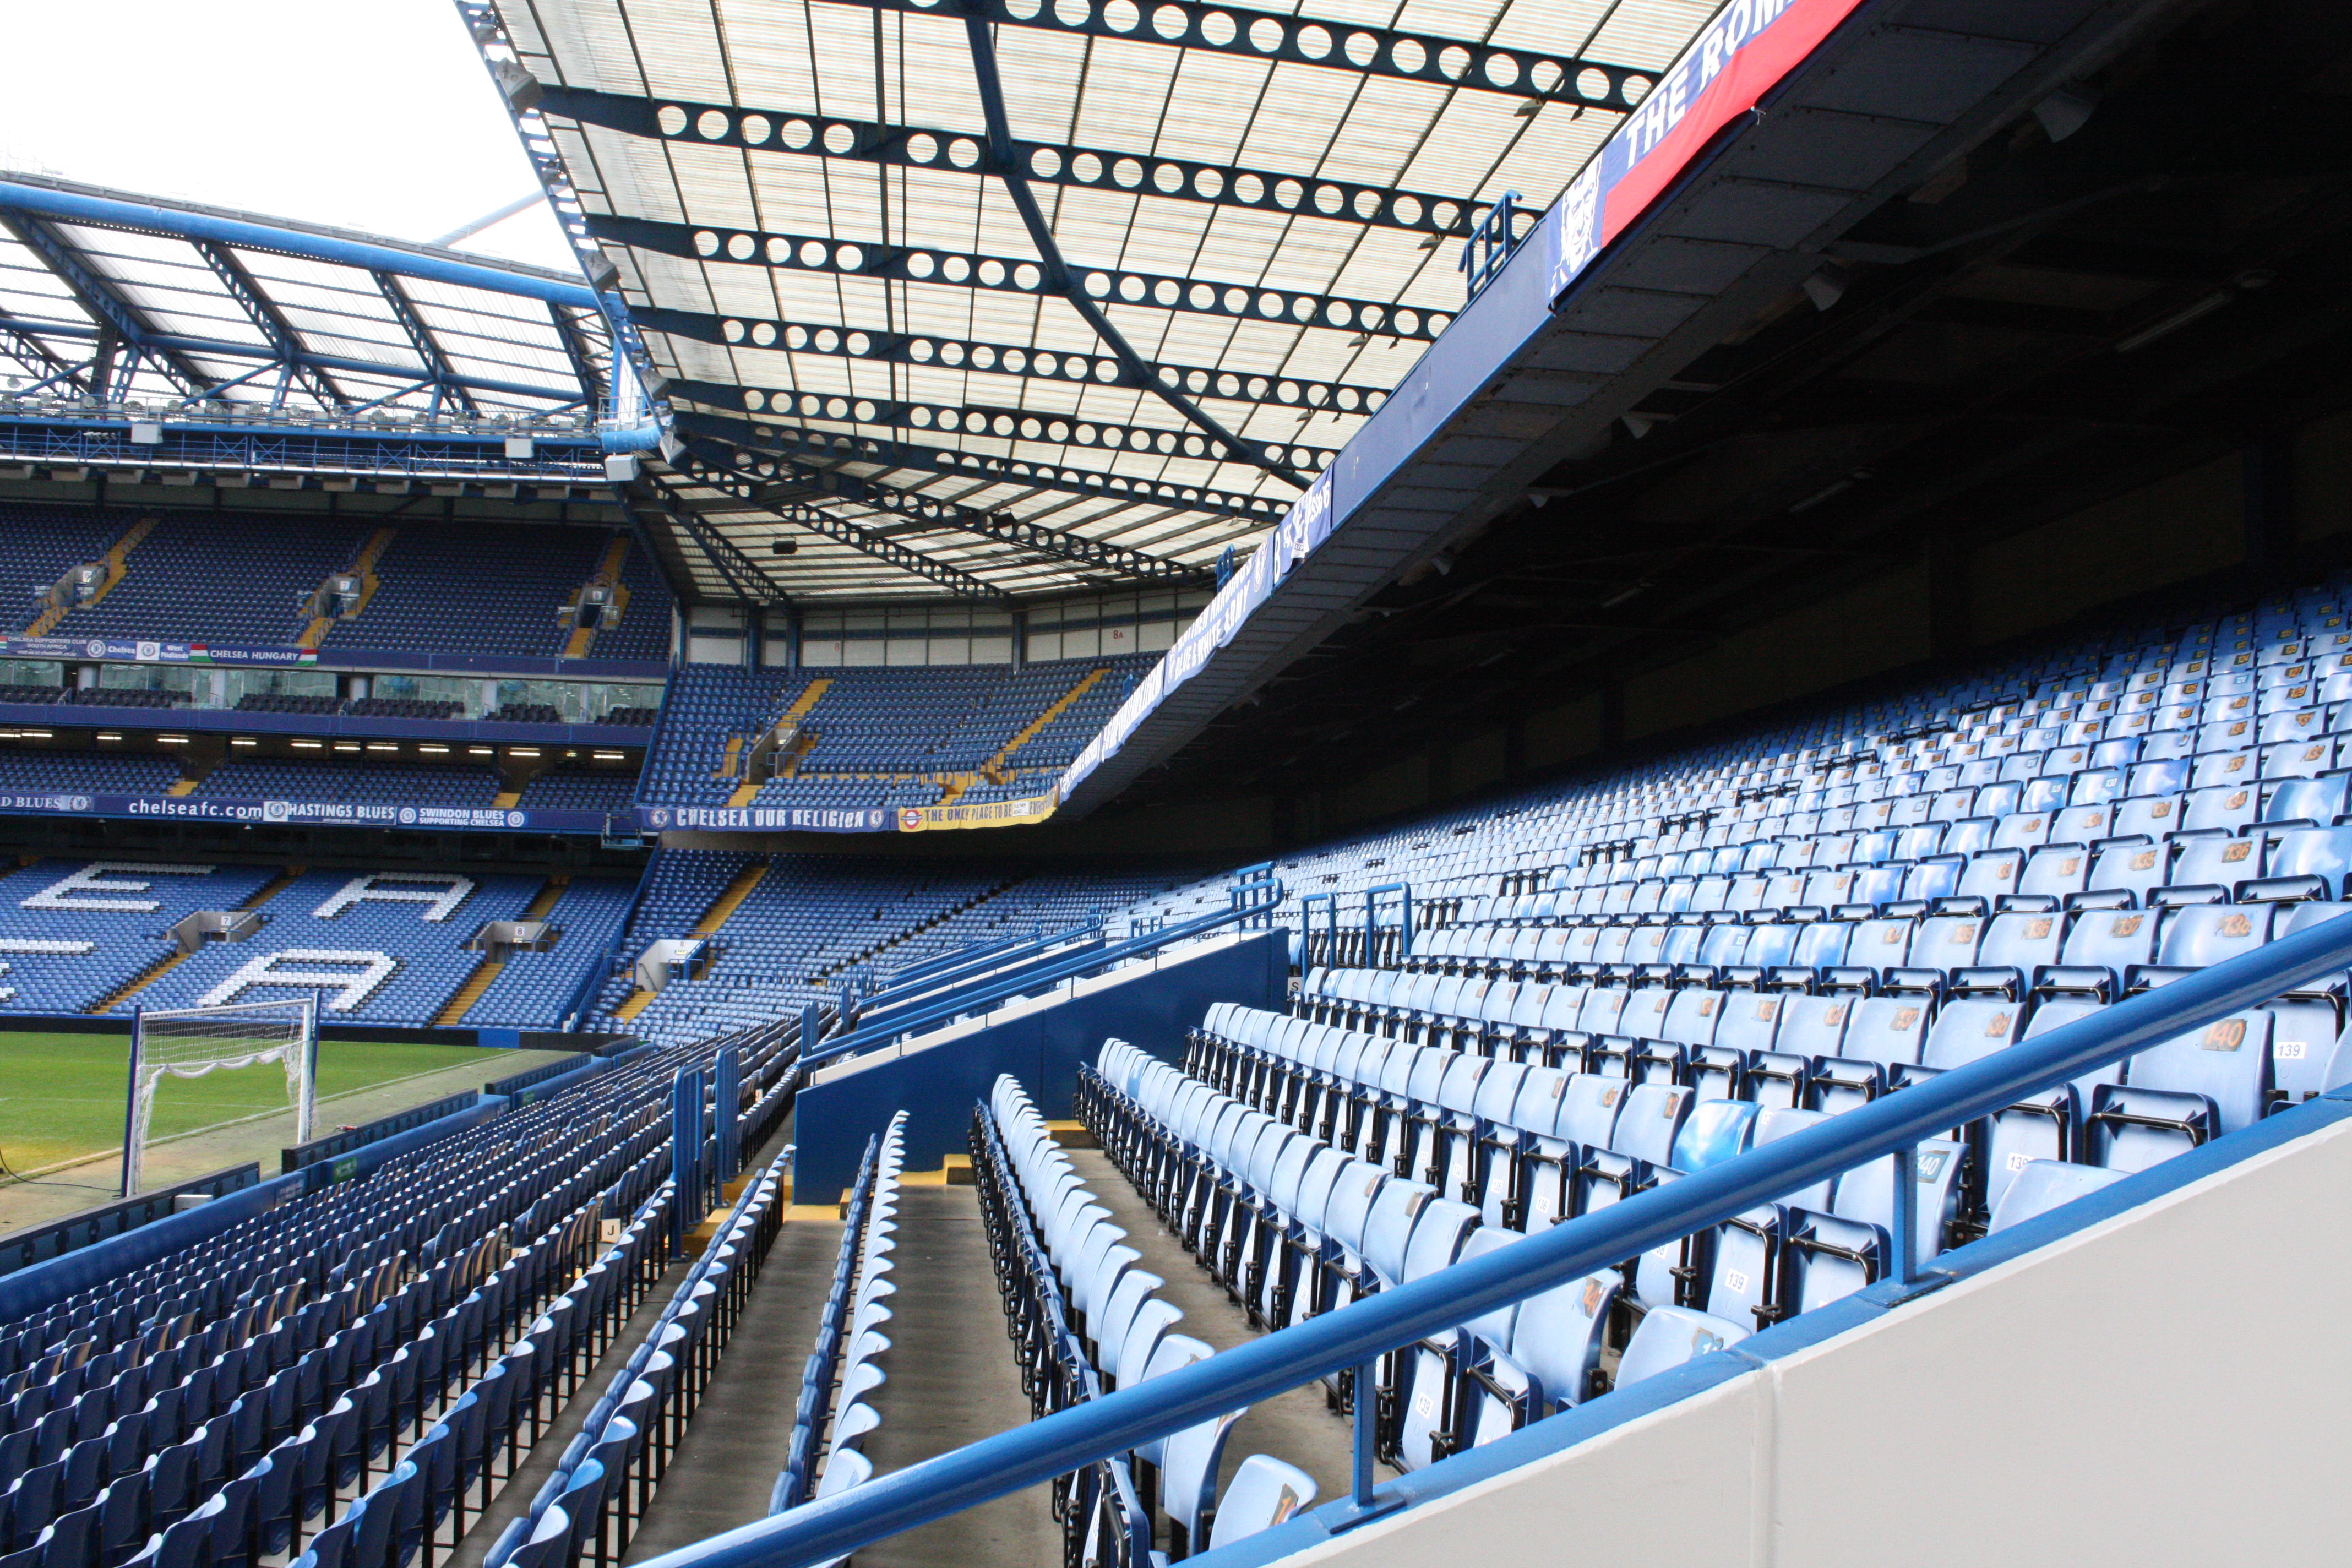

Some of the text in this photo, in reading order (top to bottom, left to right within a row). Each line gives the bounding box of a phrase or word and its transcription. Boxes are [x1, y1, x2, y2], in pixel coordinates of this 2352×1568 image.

[1626, 0, 1794, 170] THE ROM
[1113, 629, 1124, 639] 8A
[210, 650, 298, 661] CHELSEA HUNGARY
[1174, 645, 1191, 682] BLUE
[1198, 618, 1222, 664] WHITE
[15, 797, 61, 808] BLUES
[129, 799, 262, 818] chelseafc.com
[288, 803, 395, 819] HASTINGS BLUES
[419, 808, 505, 819] SWINDON BLUES
[677, 809, 865, 828] CHELSEA OUR RELIGION
[925, 809, 943, 821] THE
[947, 808, 970, 821] ONLY
[971, 807, 993, 820] PLACE
[994, 805, 1003, 819] TO
[1003, 804, 1012, 818] BE
[419, 818, 505, 827] SUPPORTING CHELSEA
[2136, 851, 2157, 867] 135
[2226, 842, 2251, 860] 136
[2120, 916, 2143, 935] 137
[2225, 912, 2251, 935] 138
[1291, 982, 1299, 991] S
[2207, 1022, 2244, 1046] 140
[2278, 1044, 2300, 1057] 139
[1538, 1199, 1547, 1211] 136
[607, 1224, 615, 1235] J
[1727, 1272, 1745, 1290] 139
[1418, 1395, 1432, 1413] 139
